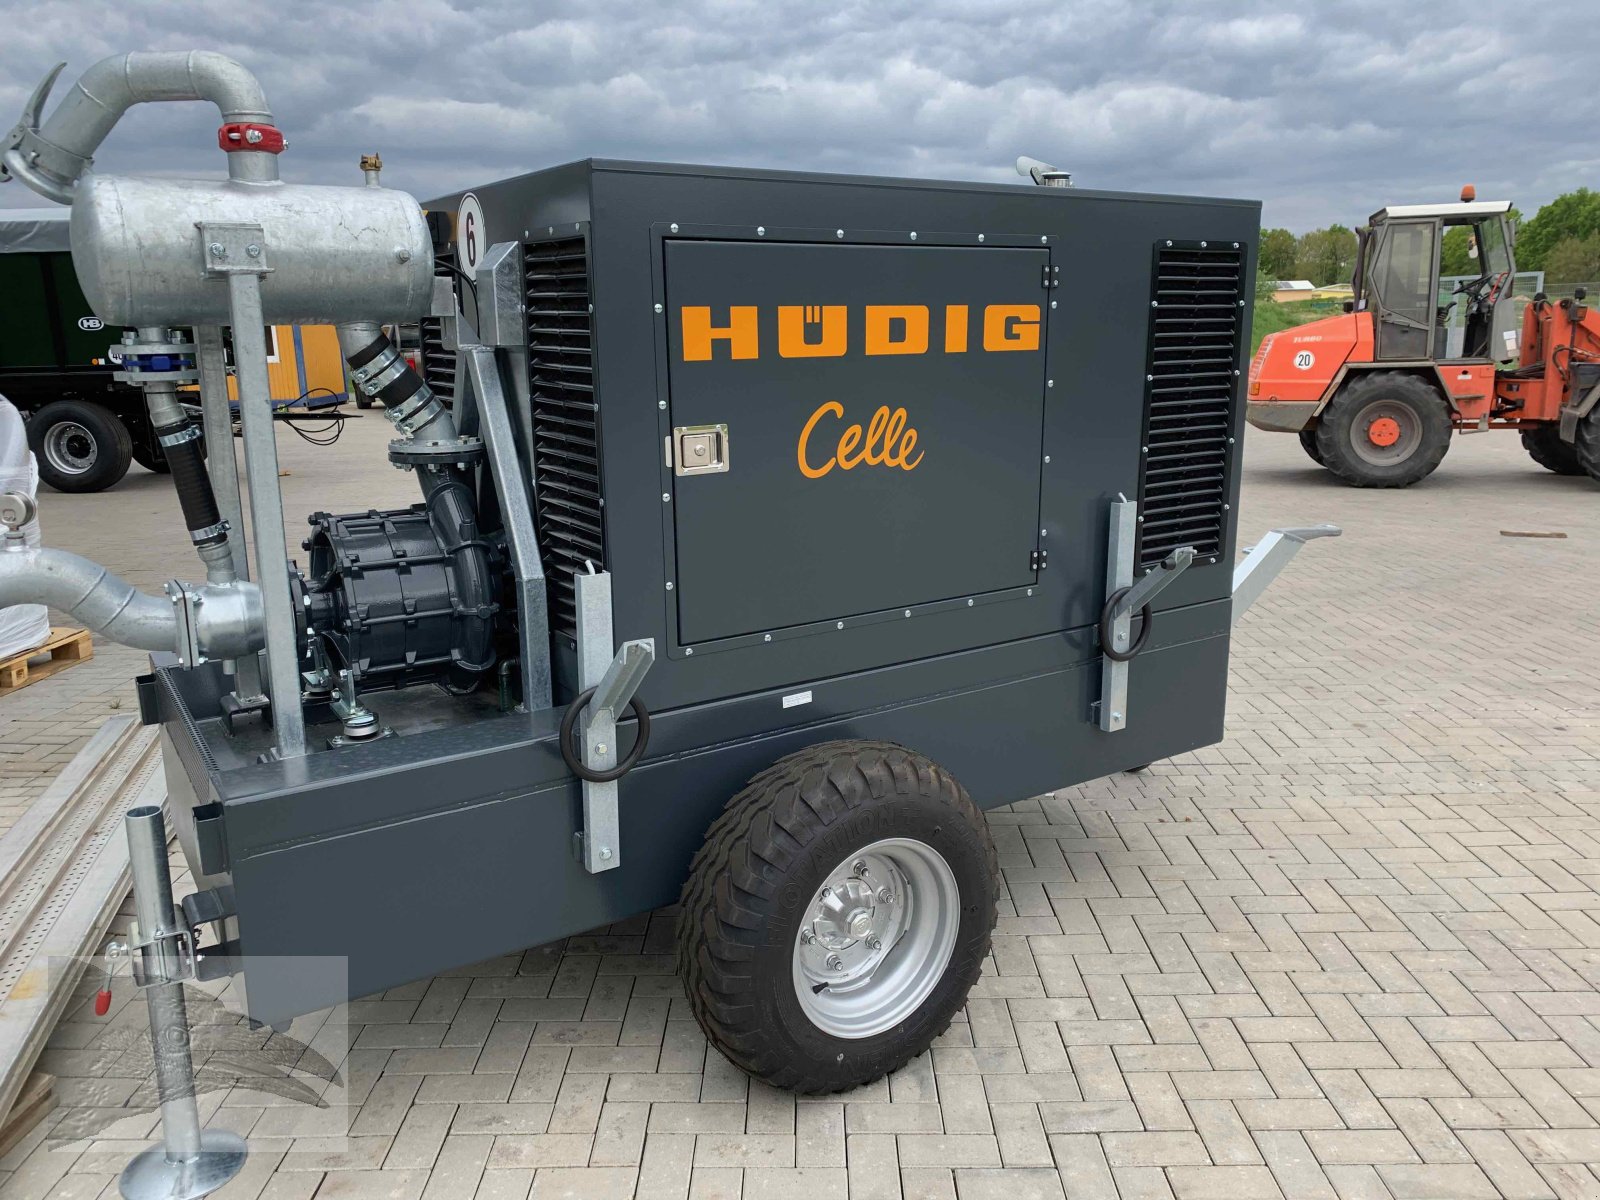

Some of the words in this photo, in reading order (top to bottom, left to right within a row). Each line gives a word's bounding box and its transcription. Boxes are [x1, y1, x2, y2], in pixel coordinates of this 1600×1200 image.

[466, 212, 476, 267] 6
[682, 304, 1041, 361] HÜDIG
[1298, 354, 1311, 366] 20
[797, 401, 925, 479] Celle
